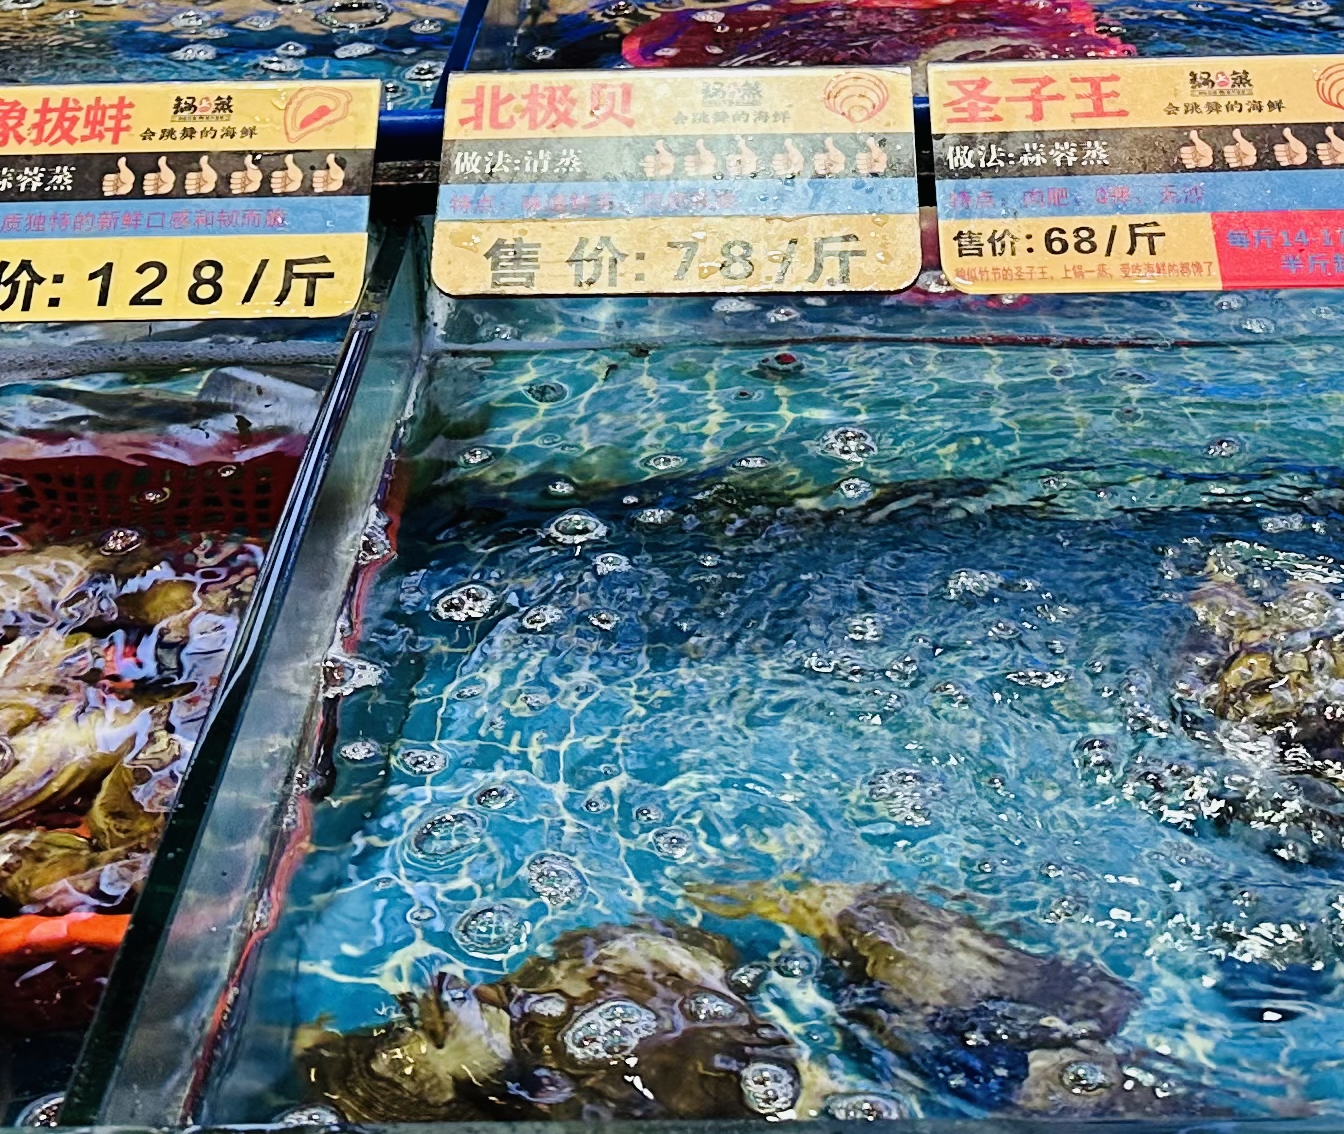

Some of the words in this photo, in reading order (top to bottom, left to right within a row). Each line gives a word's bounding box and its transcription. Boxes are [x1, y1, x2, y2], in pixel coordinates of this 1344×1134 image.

[458, 82, 636, 132] 北极贝
[942, 73, 1129, 126] 圣子王
[1163, 99, 1286, 115] 会跳舞的海鲜
[139, 125, 258, 141] 会跳舞的海鲜
[453, 149, 583, 175] 做法:清蒸
[947, 141, 1111, 170] 做法:蒜蓉蒸
[953, 221, 1166, 258] 售价:68/斤
[483, 233, 866, 289] 售价:78/斤
